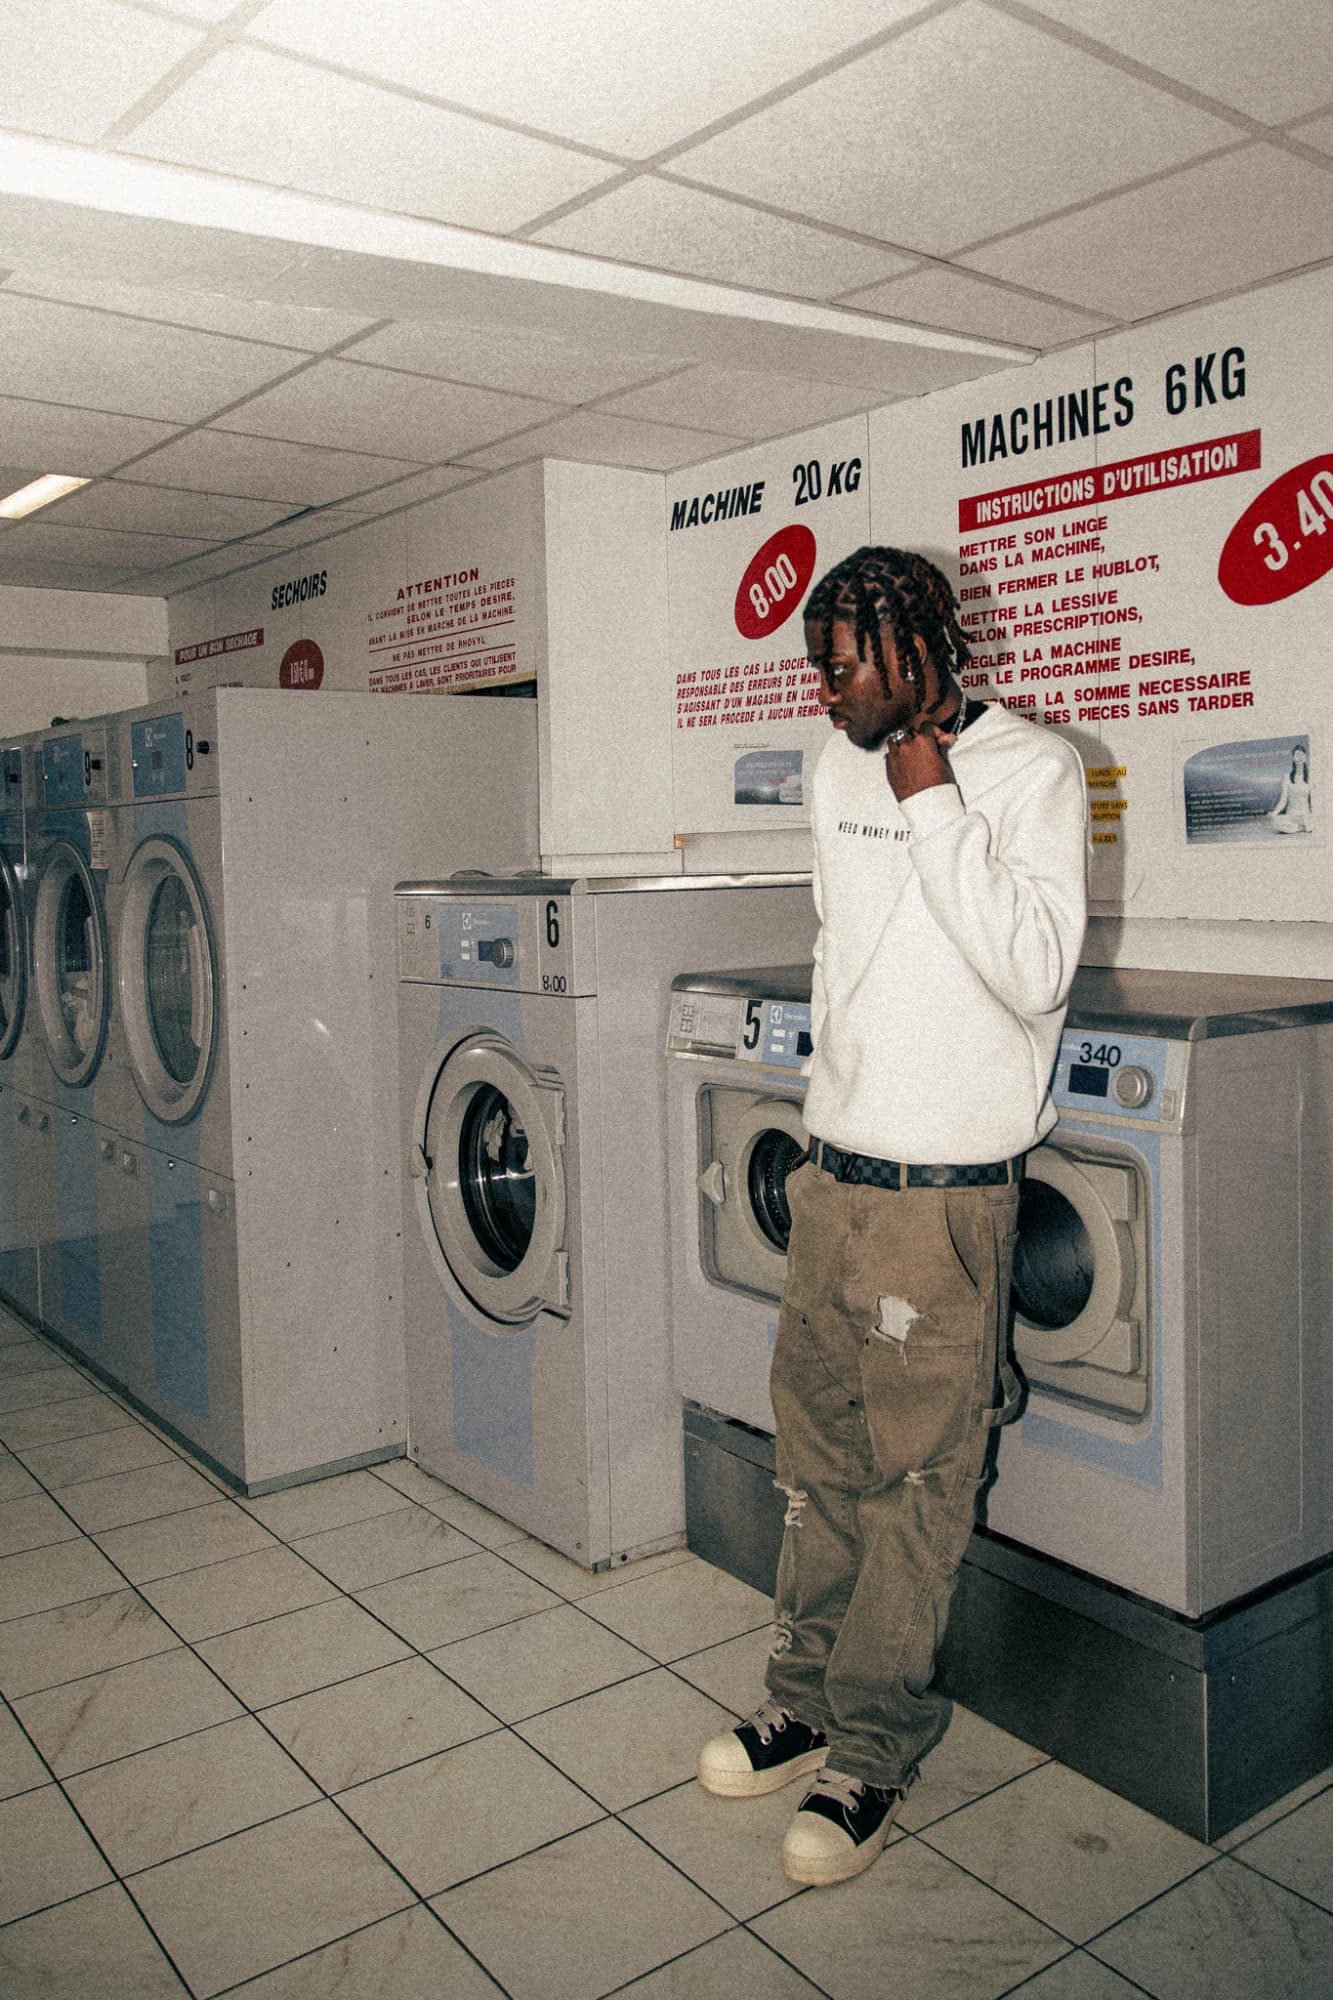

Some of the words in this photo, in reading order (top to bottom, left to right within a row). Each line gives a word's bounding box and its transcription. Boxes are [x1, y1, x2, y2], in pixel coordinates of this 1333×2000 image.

[961, 376, 1135, 469] MACHINES
[976, 476, 1095, 524] INSTRUCTIONS
[1103, 442, 1239, 496] D'UTILISATION
[670, 481, 766, 531] MACHINE
[959, 535, 1017, 559] METTRE
[1023, 527, 1055, 545] SON
[1062, 516, 1108, 538] LINGE
[959, 557, 998, 576] DANS
[1004, 553, 1024, 568] LA
[1031, 537, 1105, 563] MACHINE,
[271, 569, 328, 611] SECHOIRS
[396, 567, 480, 601] ATTENTION
[749, 553, 798, 619] 8.00
[959, 584, 992, 602] BIEN
[998, 573, 1058, 596] FERMER
[1065, 568, 1085, 584] LE
[1092, 554, 1160, 579] HUBLOT,
[376, 606, 405, 621] CONVIENT
[418, 596, 443, 610] METTRE
[445, 589, 471, 602] TOUTES
[474, 584, 487, 596] LES
[490, 577, 516, 592] PIECES
[406, 611, 432, 625] SELON
[435, 607, 445, 618] LE
[449, 599, 477, 614] TEMPS
[960, 606, 1018, 627] METTRE
[1024, 602, 1045, 617] LA
[1052, 590, 1119, 613] LESSIVE
[389, 631, 397, 642] LA
[428, 619, 455, 633] MARCHE
[457, 616, 467, 626] DE
[470, 613, 478, 623] LA
[1013, 606, 1144, 638] PRESCRIPTIONS,
[403, 650, 415, 661] PAS
[418, 645, 443, 658] METTRE
[446, 641, 455, 651] DE
[1023, 648, 1044, 662] LA
[1050, 637, 1122, 660] MACHINE
[499, 663, 517, 676] POUR
[676, 671, 697, 685] DANS
[700, 669, 721, 682] TOUS
[724, 665, 740, 679] LES
[743, 663, 760, 676] CAS
[764, 661, 775, 673] LA
[961, 673, 989, 689] SUR
[995, 670, 1014, 685] LE
[1020, 657, 1121, 682] PROGRAMME
[1128, 648, 1196, 670] DESIRE,
[676, 685, 728, 700] RESPONSABLE
[730, 681, 744, 693] DES
[748, 676, 783, 692] ERREURS
[786, 674, 797, 687] DE
[677, 699, 721, 714] S'AGISSANT
[724, 696, 742, 710] D'UN
[746, 692, 783, 707] MAGASIN
[786, 690, 798, 703] EN
[1045, 691, 1065, 706] LA
[1074, 684, 1131, 702] SOMME
[1138, 670, 1251, 697] NECESSAIRE
[677, 717, 684, 729] IL
[687, 715, 696, 728] NE
[699, 714, 718, 727] SERA
[721, 710, 755, 724] PROCEDE
[758, 709, 764, 721] A
[768, 706, 794, 721] AUCUN
[1044, 710, 1071, 725] SES
[1078, 705, 1131, 722] PIECES
[1138, 699, 1180, 717] SANS
[1188, 691, 1255, 712] TARDER
[185, 729, 194, 771] 8
[838, 821, 858, 835] NEED
[862, 825, 890, 839] MONEY
[894, 830, 911, 842] NOT
[424, 914, 432, 930] 6
[545, 899, 561, 949] 6
[743, 1000, 764, 1050] 5
[1079, 1042, 1122, 1067] 340
